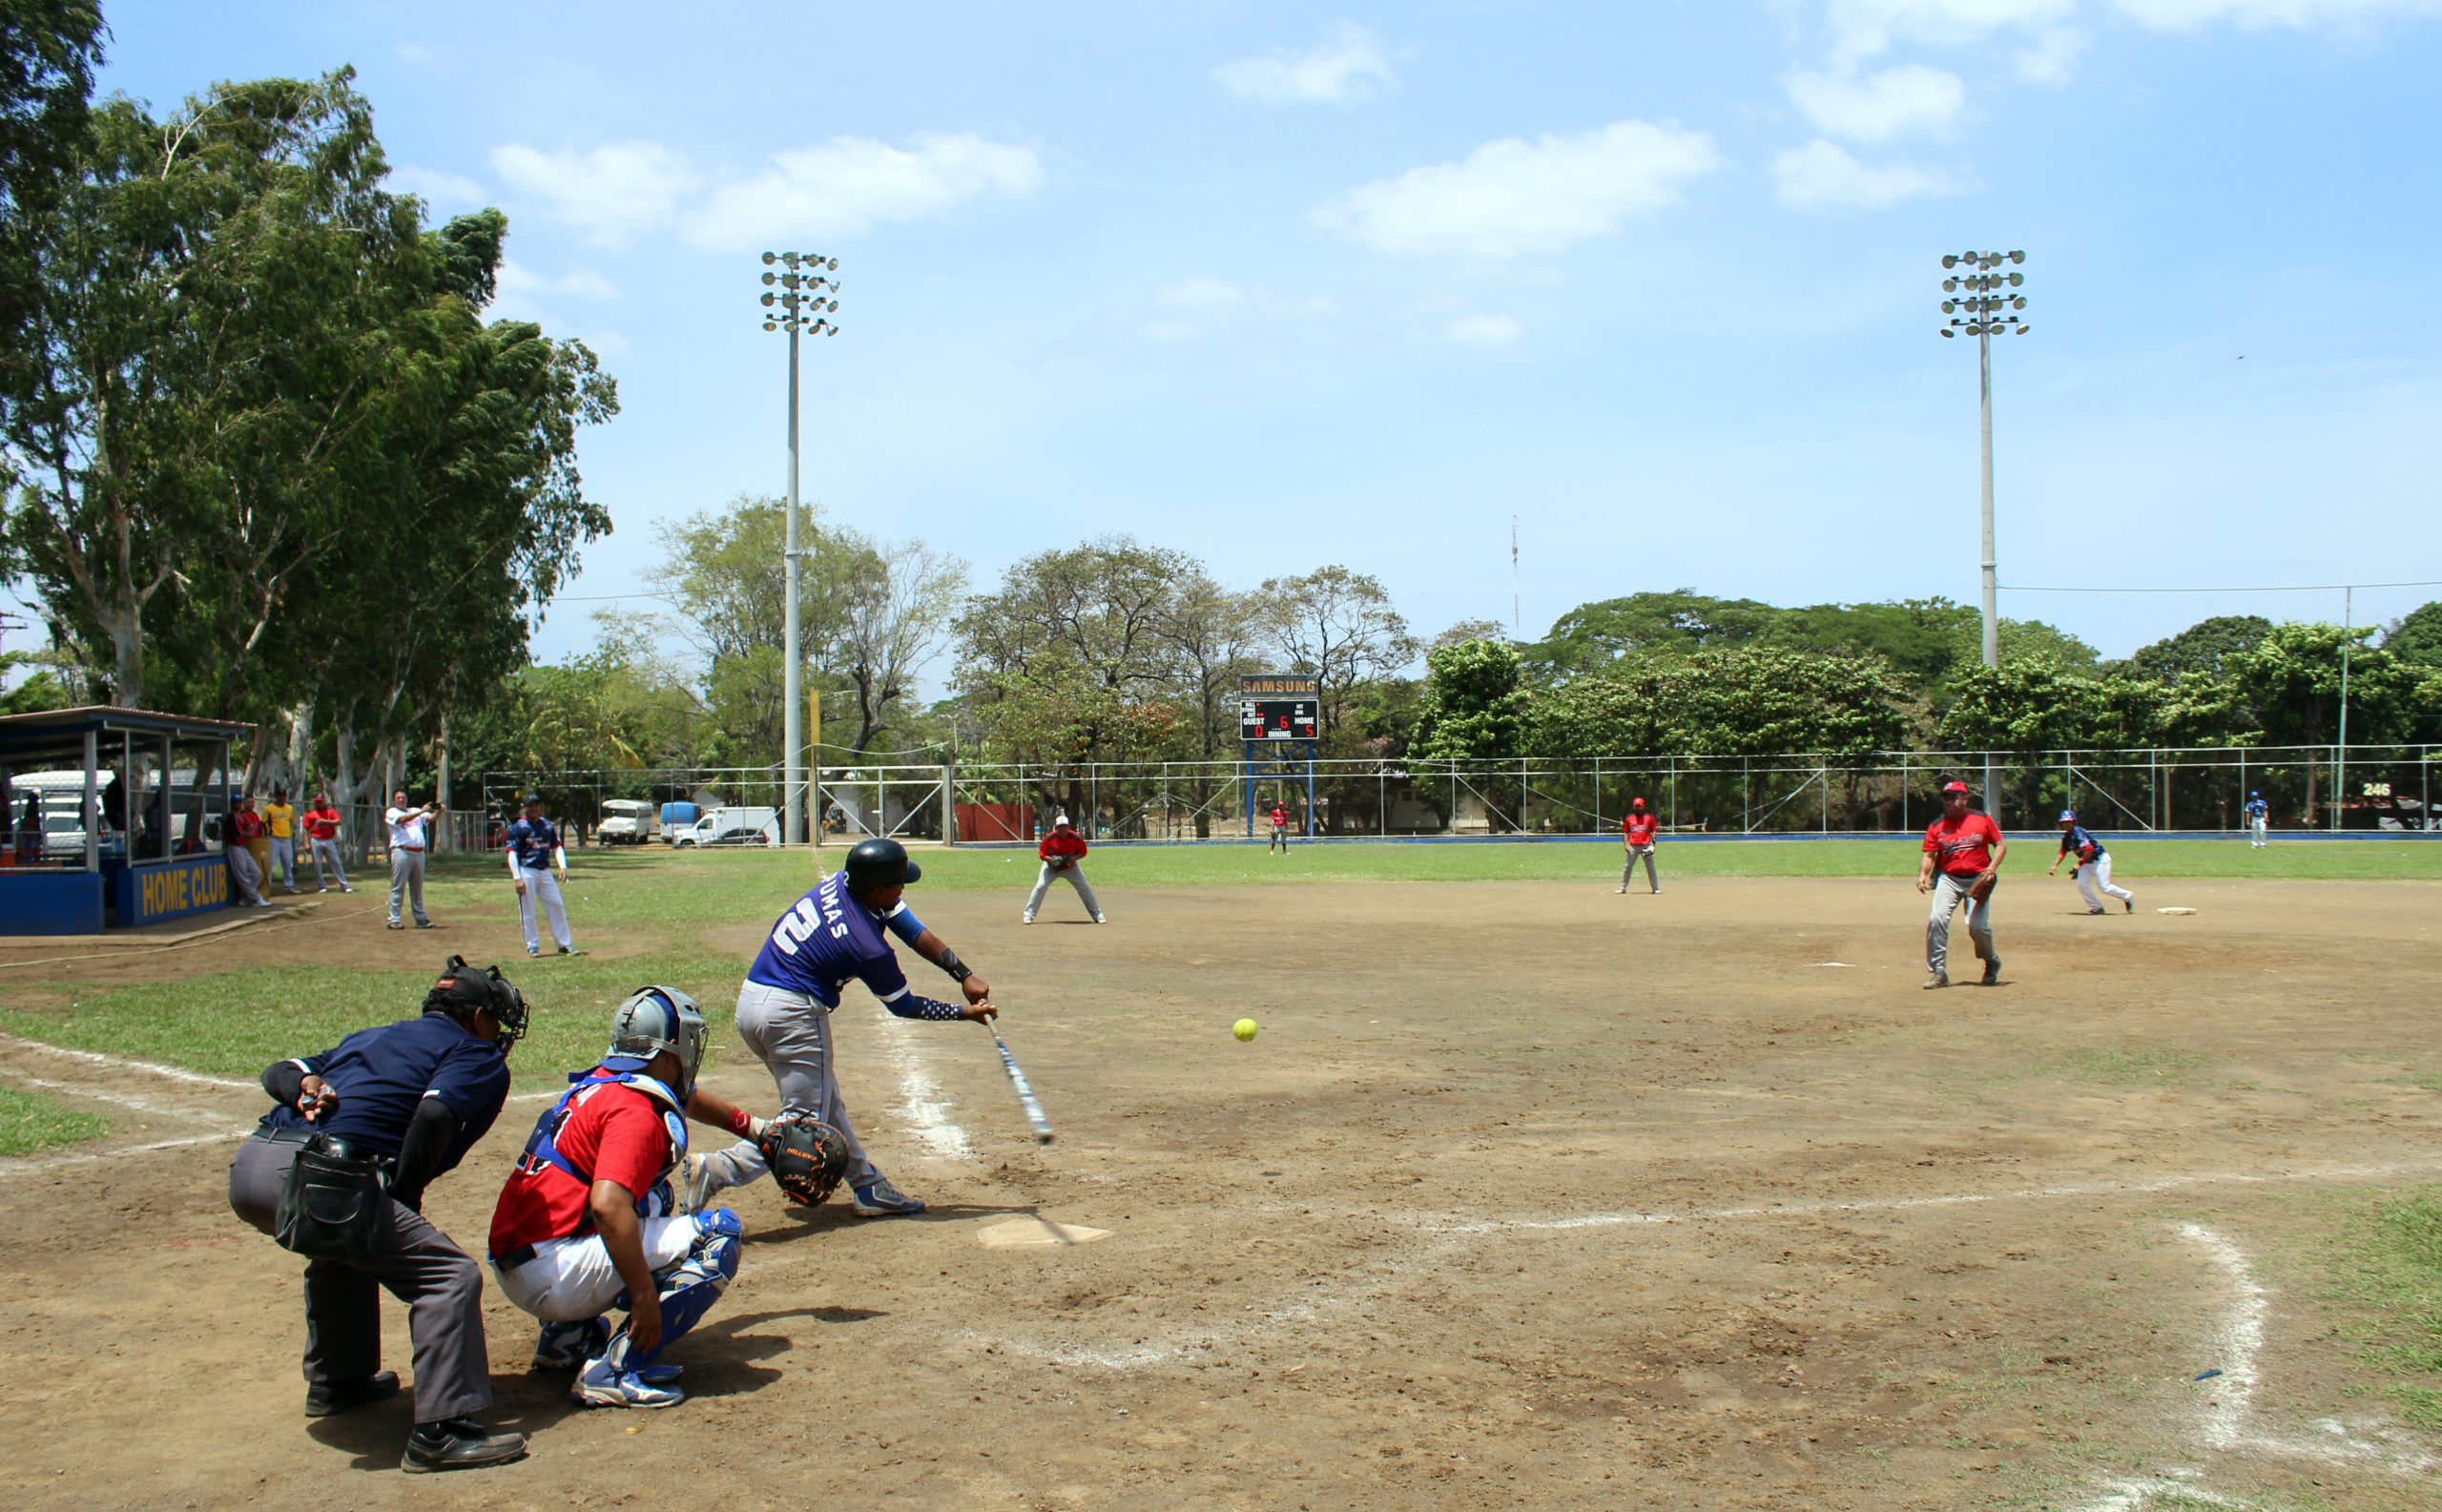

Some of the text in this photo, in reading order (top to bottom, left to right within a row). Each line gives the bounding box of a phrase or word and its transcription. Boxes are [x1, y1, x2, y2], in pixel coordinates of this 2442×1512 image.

[1243, 680, 1315, 693] SAMSUNG
[1280, 715, 1289, 729] 6
[1294, 716, 1314, 725] HOME
[1254, 724, 1264, 737] 0
[1268, 730, 1292, 738] INNING
[1305, 724, 1314, 737] 5
[2363, 782, 2391, 797] 246
[142, 863, 228, 917] HOME CLUB
[772, 897, 821, 956] 2
